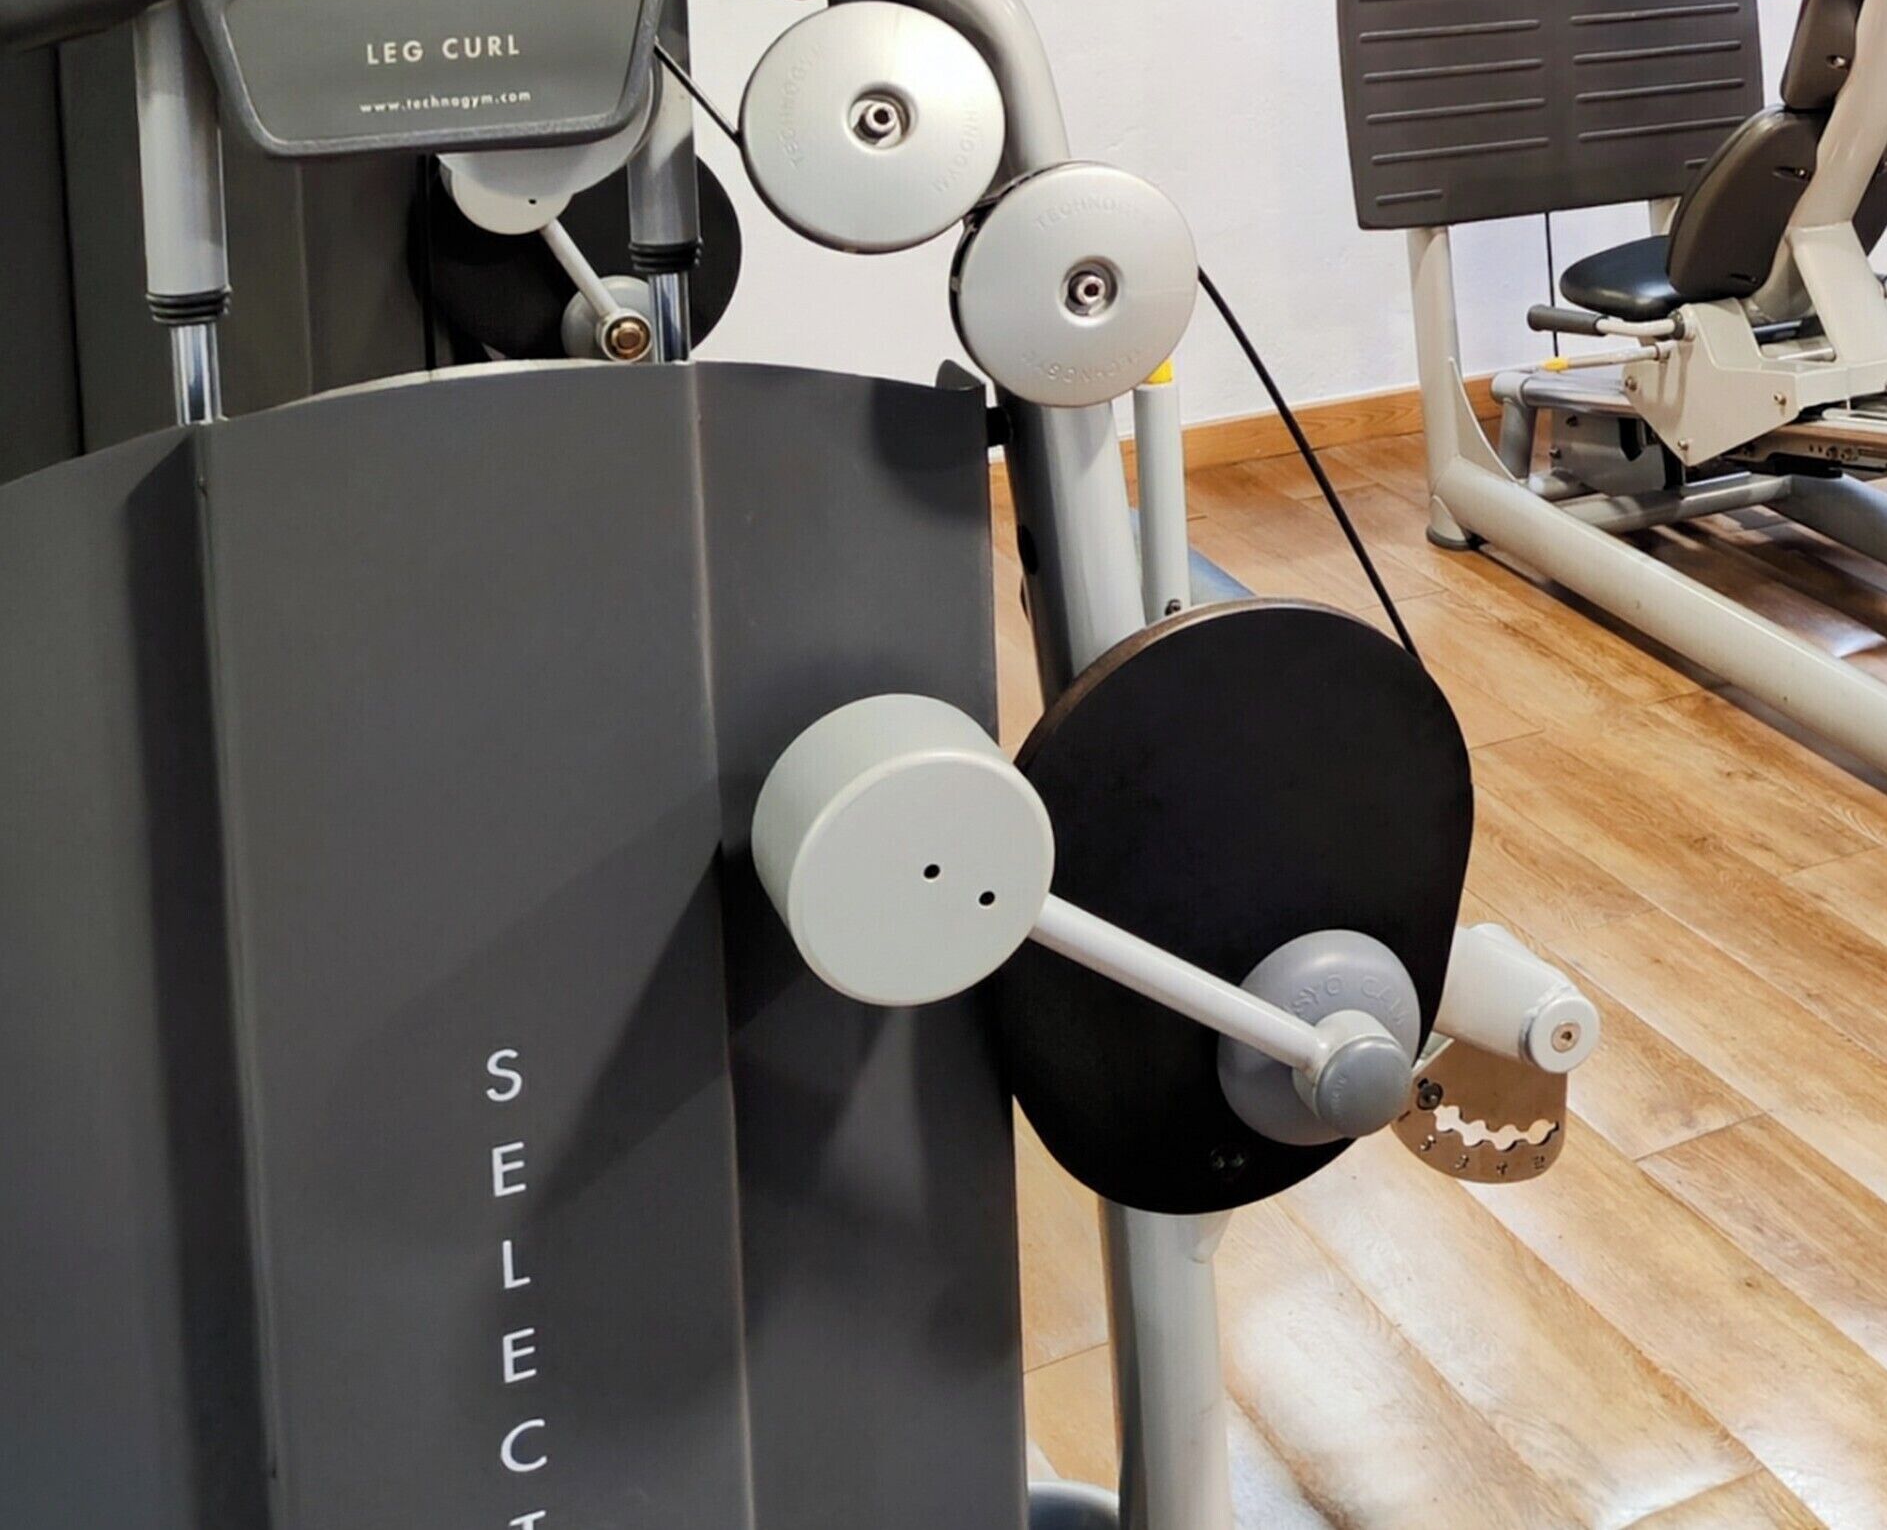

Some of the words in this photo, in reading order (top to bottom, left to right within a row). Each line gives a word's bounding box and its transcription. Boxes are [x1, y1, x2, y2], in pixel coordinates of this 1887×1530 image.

[366, 40, 424, 65] LEG
[441, 34, 521, 60] CURL
[359, 90, 532, 113] www.technogym.com
